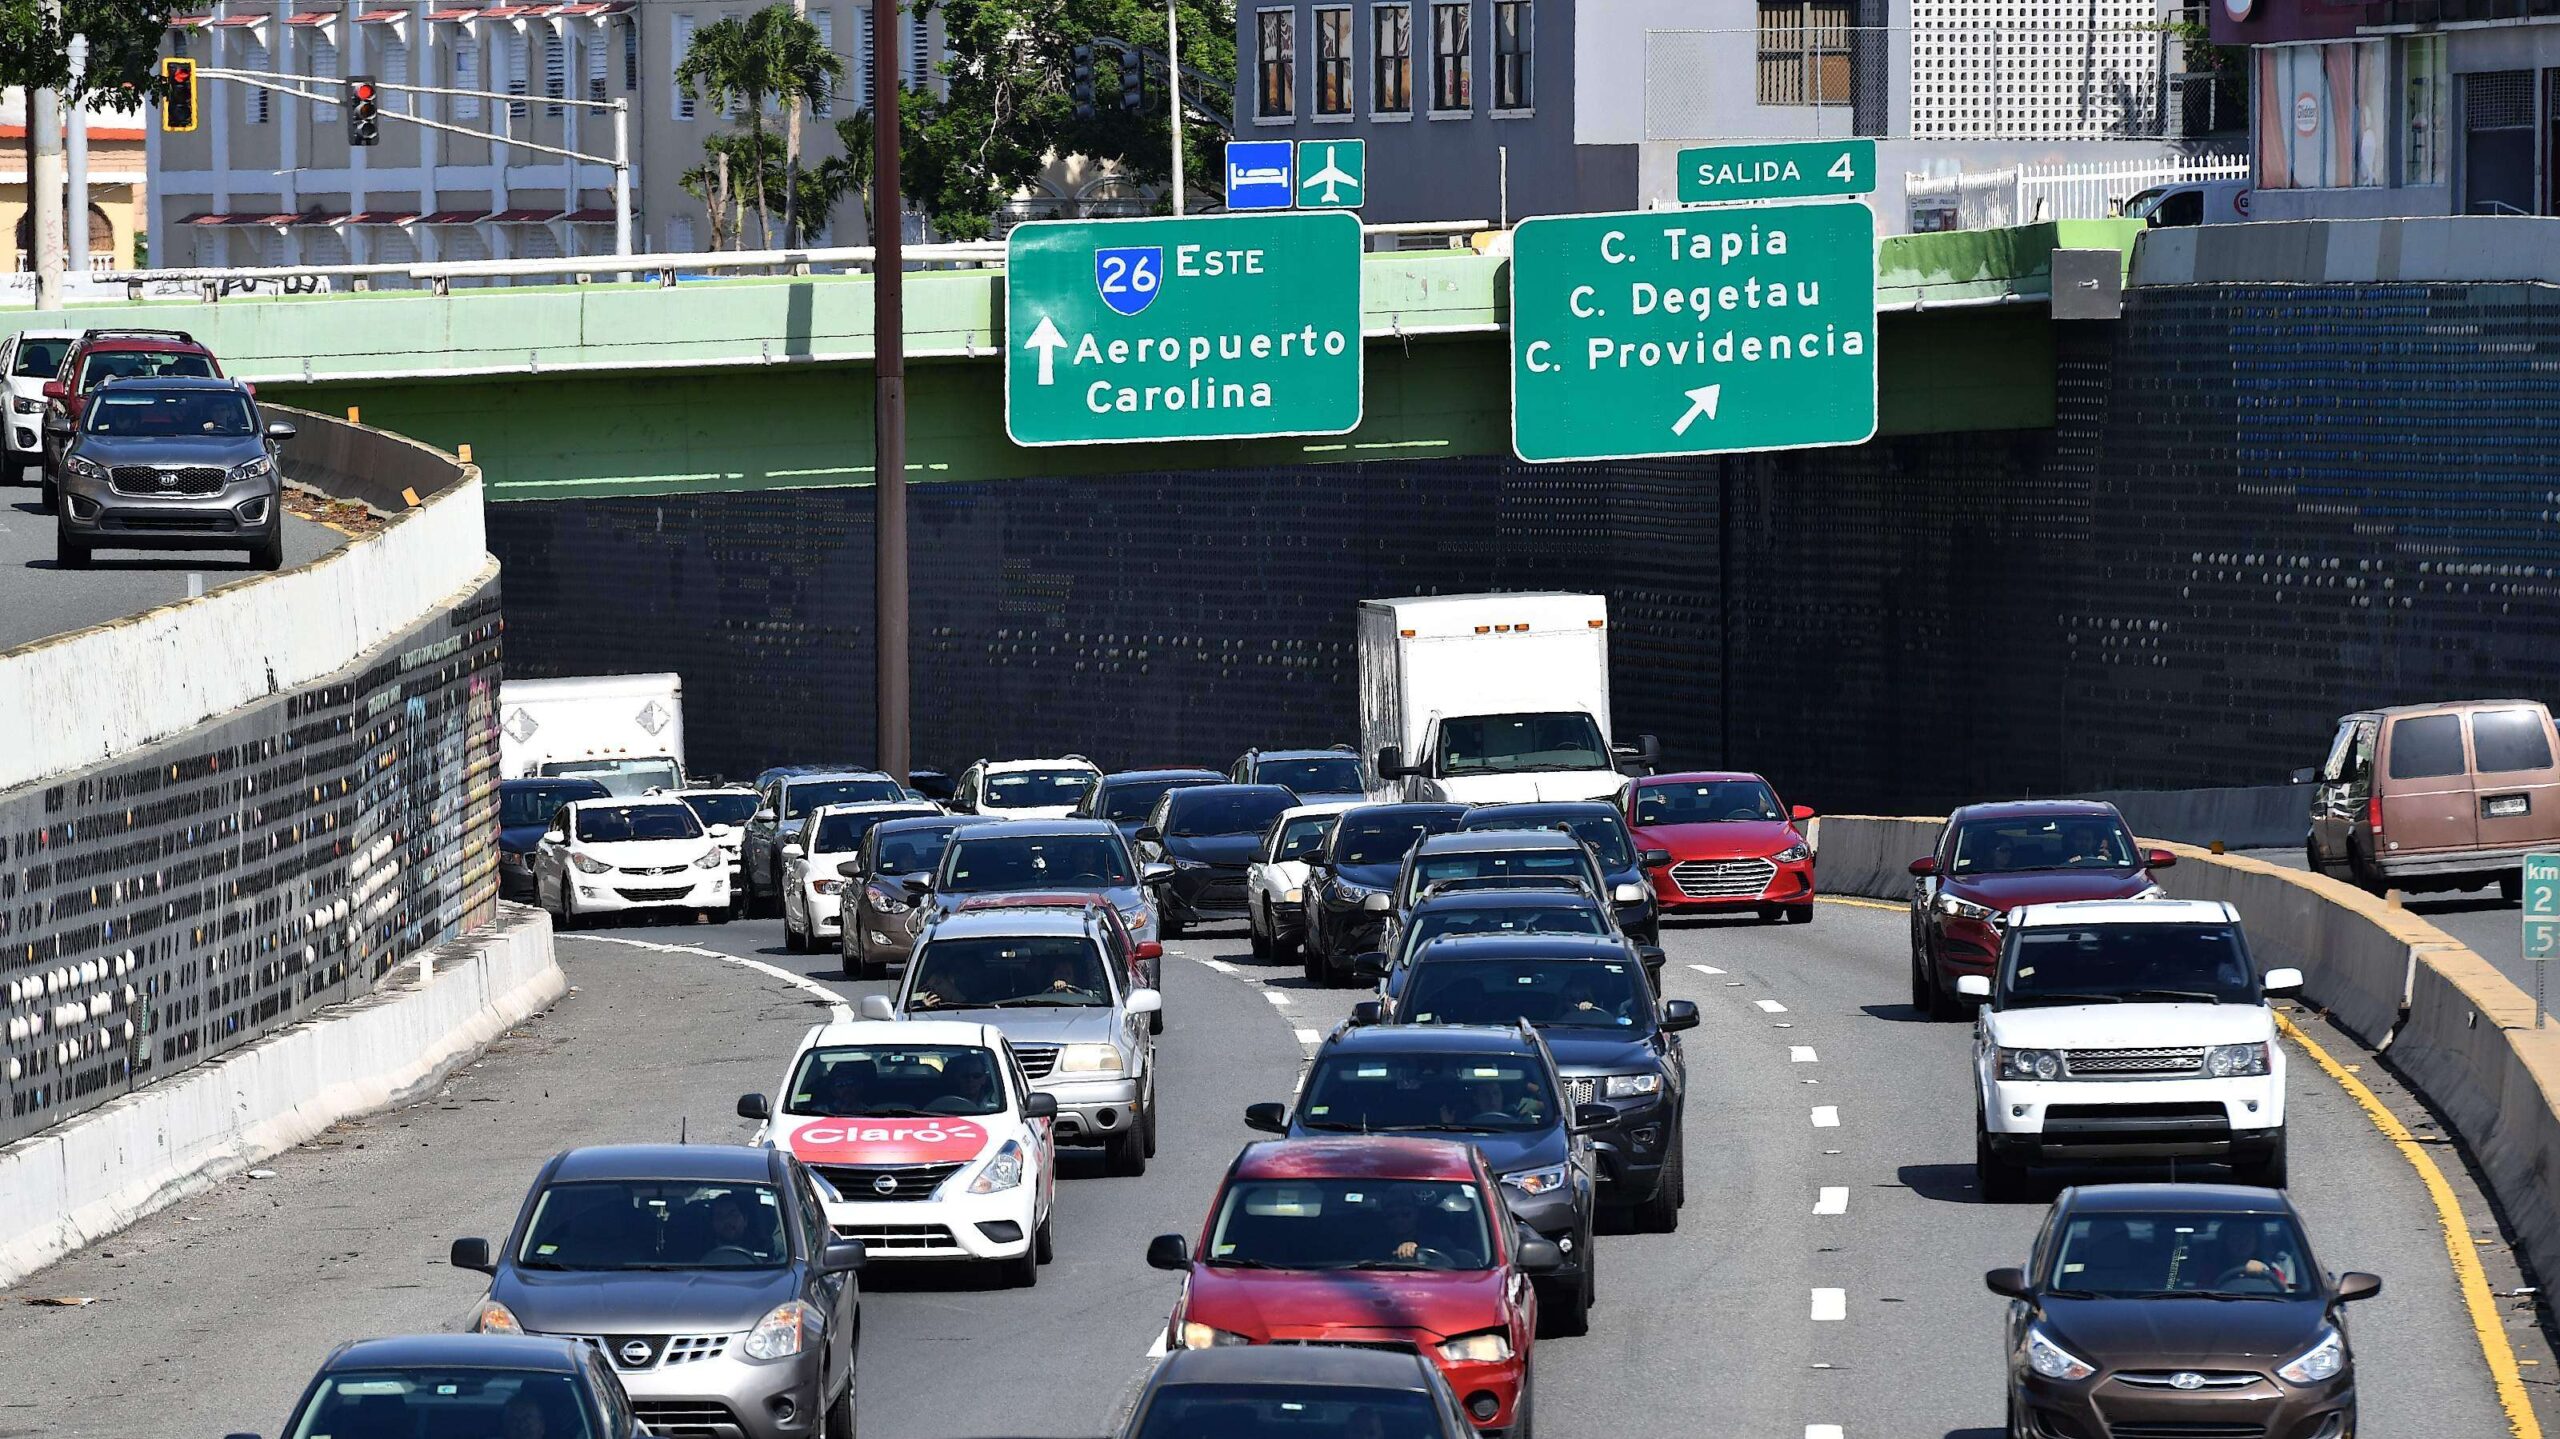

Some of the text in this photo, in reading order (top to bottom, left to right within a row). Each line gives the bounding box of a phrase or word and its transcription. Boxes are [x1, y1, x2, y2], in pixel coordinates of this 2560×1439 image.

[1698, 153, 1855, 186] SALIDA 4
[1600, 224, 1788, 265] C. Tapia
[1102, 256, 1158, 293] 26
[1569, 276, 1820, 322] C. Degetau
[1073, 324, 1346, 369] Aeropuerto
[1525, 324, 1864, 373] C. Providencia
[1086, 377, 1272, 414] Carolina
[2527, 863, 2559, 880] km
[2534, 886, 2553, 912] 2
